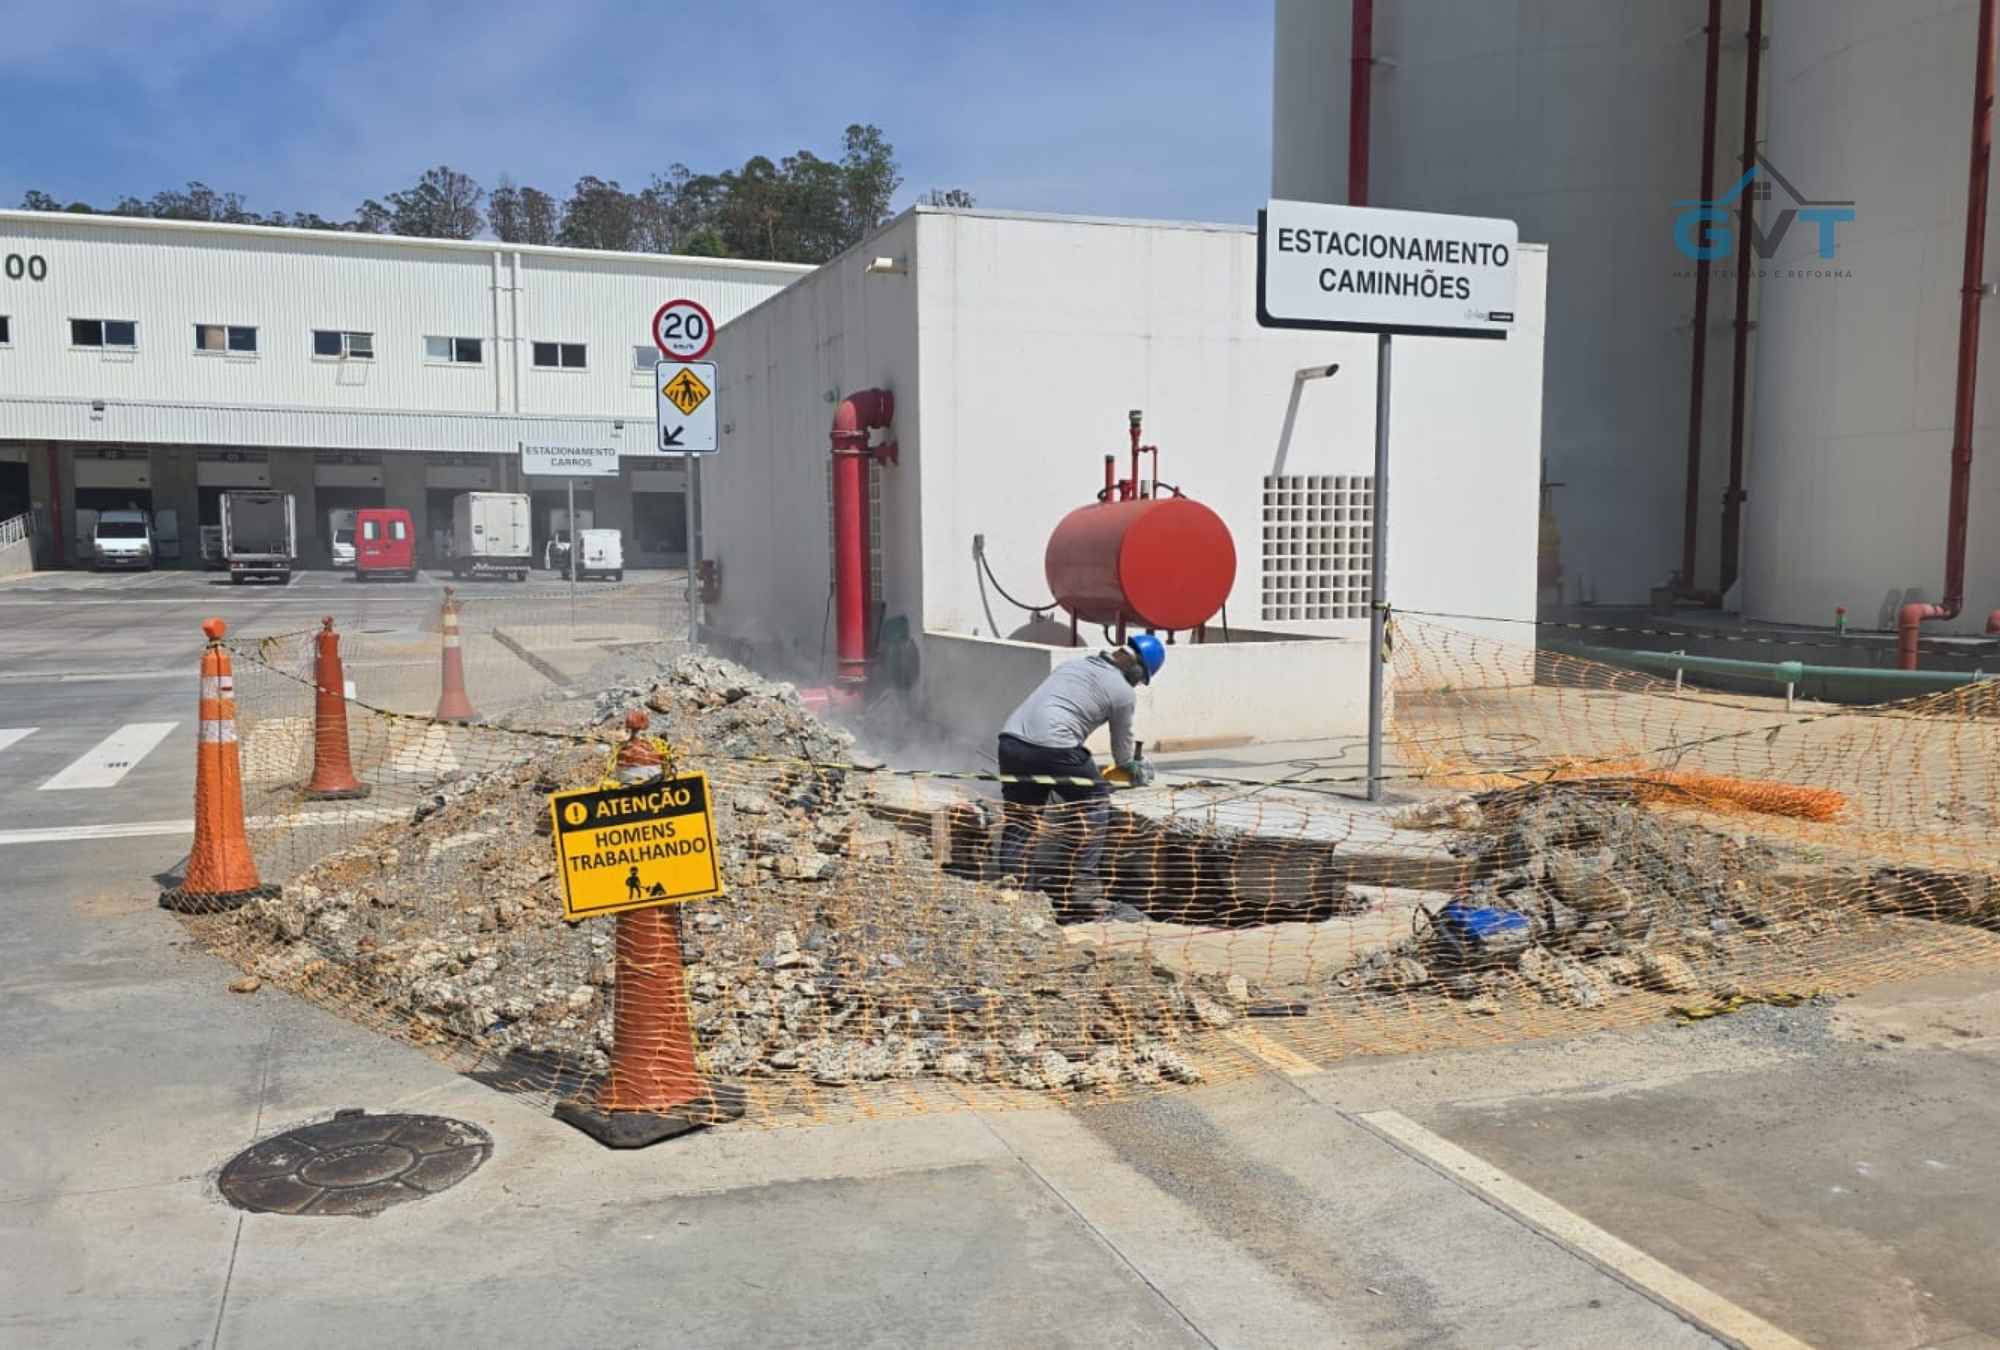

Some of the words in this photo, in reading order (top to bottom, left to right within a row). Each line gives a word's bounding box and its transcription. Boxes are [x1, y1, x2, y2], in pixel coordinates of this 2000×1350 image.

[1278, 227, 1510, 267] ESTACIONAMENTO
[5, 253, 47, 282] 00
[1318, 268, 1471, 300] CAMINHÕES
[664, 313, 704, 340] 20
[526, 446, 616, 457] ESTACIONAMENTO
[551, 458, 593, 467] CARROS
[596, 788, 690, 817] ATENÇÃO
[595, 821, 676, 848] HOMENS
[569, 837, 706, 872] TRABALHANDO
